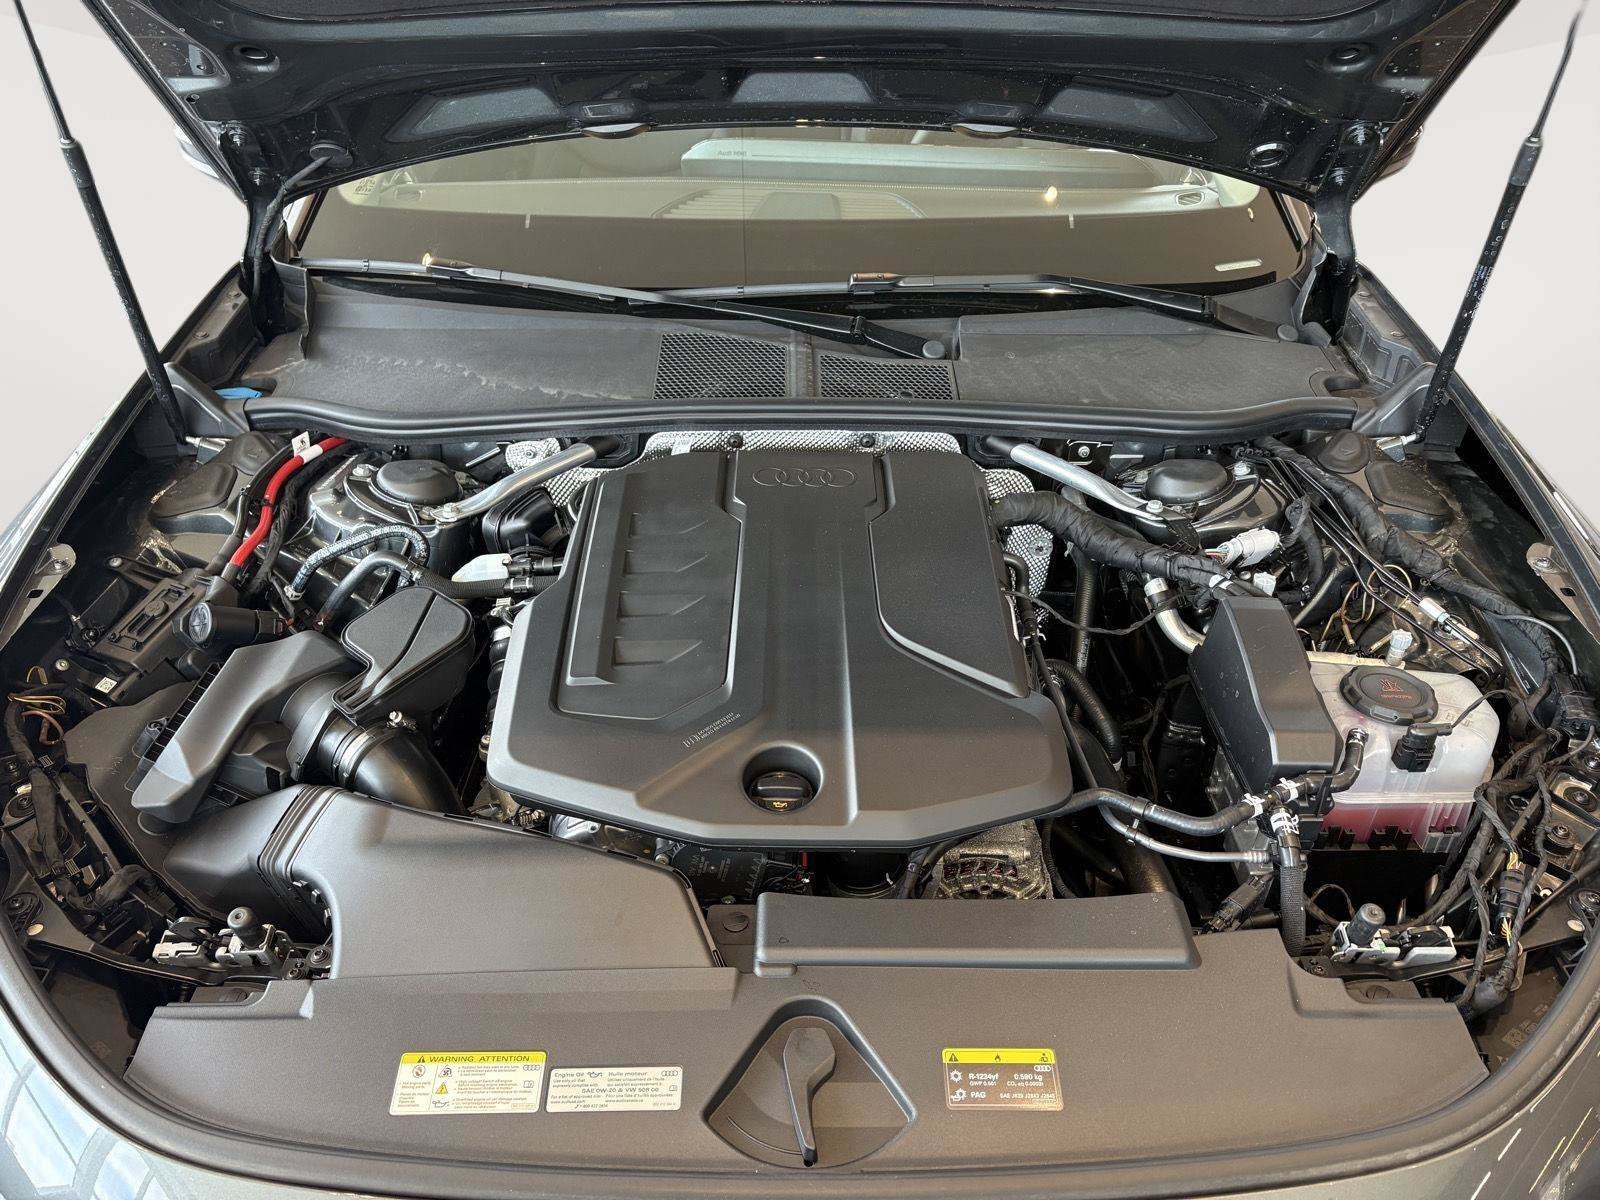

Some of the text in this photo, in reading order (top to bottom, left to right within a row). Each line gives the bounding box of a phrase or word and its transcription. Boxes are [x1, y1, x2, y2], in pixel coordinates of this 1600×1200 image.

[429, 1055, 474, 1063] WARNING
[968, 1073, 999, 1081] R-1234yf
[1034, 1073, 1043, 1082] kg
